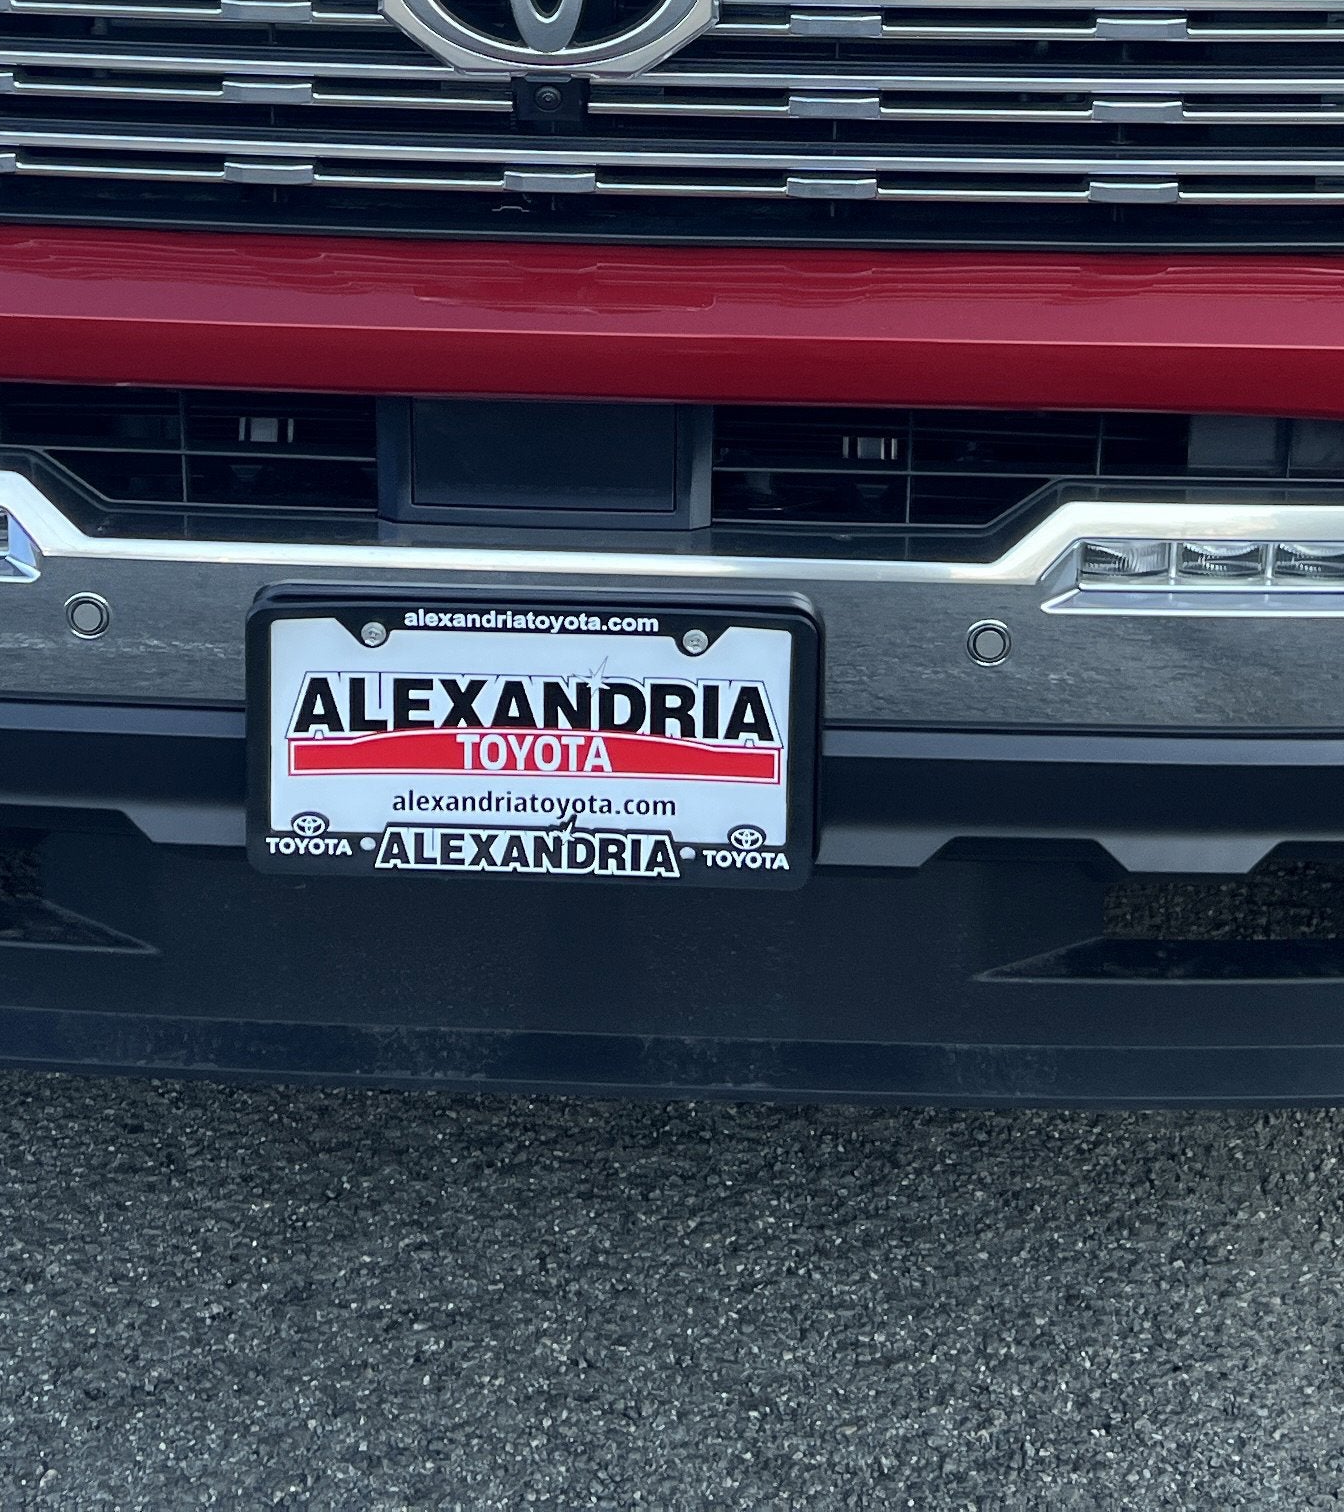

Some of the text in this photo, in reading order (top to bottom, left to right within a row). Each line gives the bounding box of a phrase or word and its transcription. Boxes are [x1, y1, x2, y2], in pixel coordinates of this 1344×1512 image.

[404, 609, 660, 634] alexandriatoyota.com
[292, 677, 775, 742] ALEXANDRIA
[456, 734, 613, 773] TOYOTA
[392, 790, 676, 820] alexandriatoyota.com
[266, 837, 353, 856] TOYOTA
[377, 828, 678, 876] ALEXANDRIA
[703, 850, 789, 871] TOYOTA
